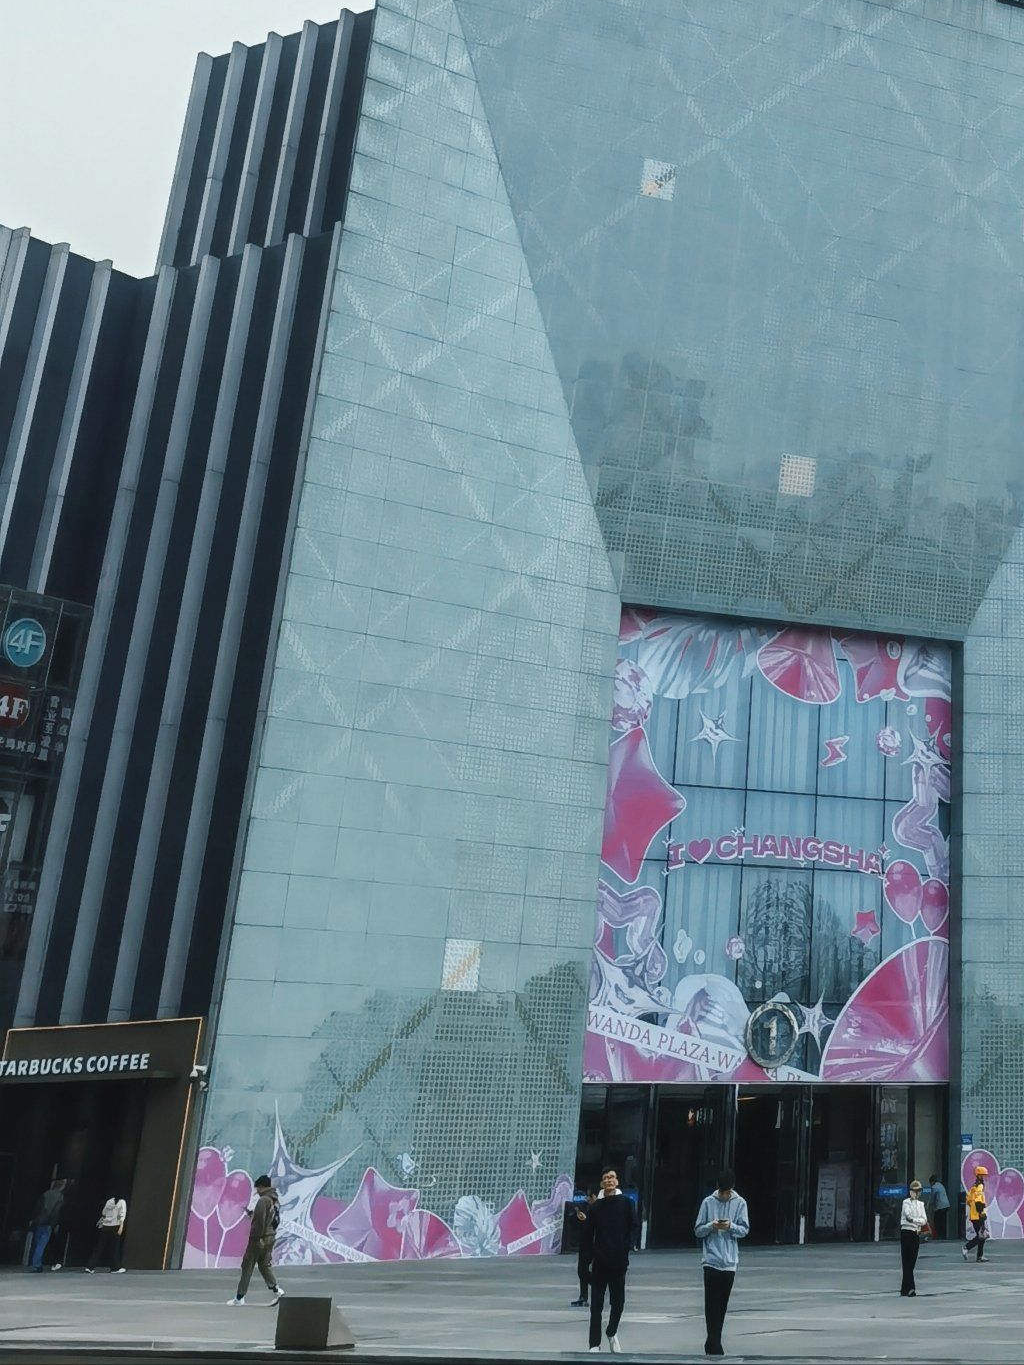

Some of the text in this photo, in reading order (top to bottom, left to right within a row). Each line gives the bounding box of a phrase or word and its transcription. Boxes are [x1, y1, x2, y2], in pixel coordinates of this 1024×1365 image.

[8, 628, 43, 655] 4F
[0, 695, 29, 720] 4F
[715, 833, 886, 876] CHANGSHA
[587, 1009, 652, 1046] WANDA
[86, 1052, 151, 1073] COFFEE
